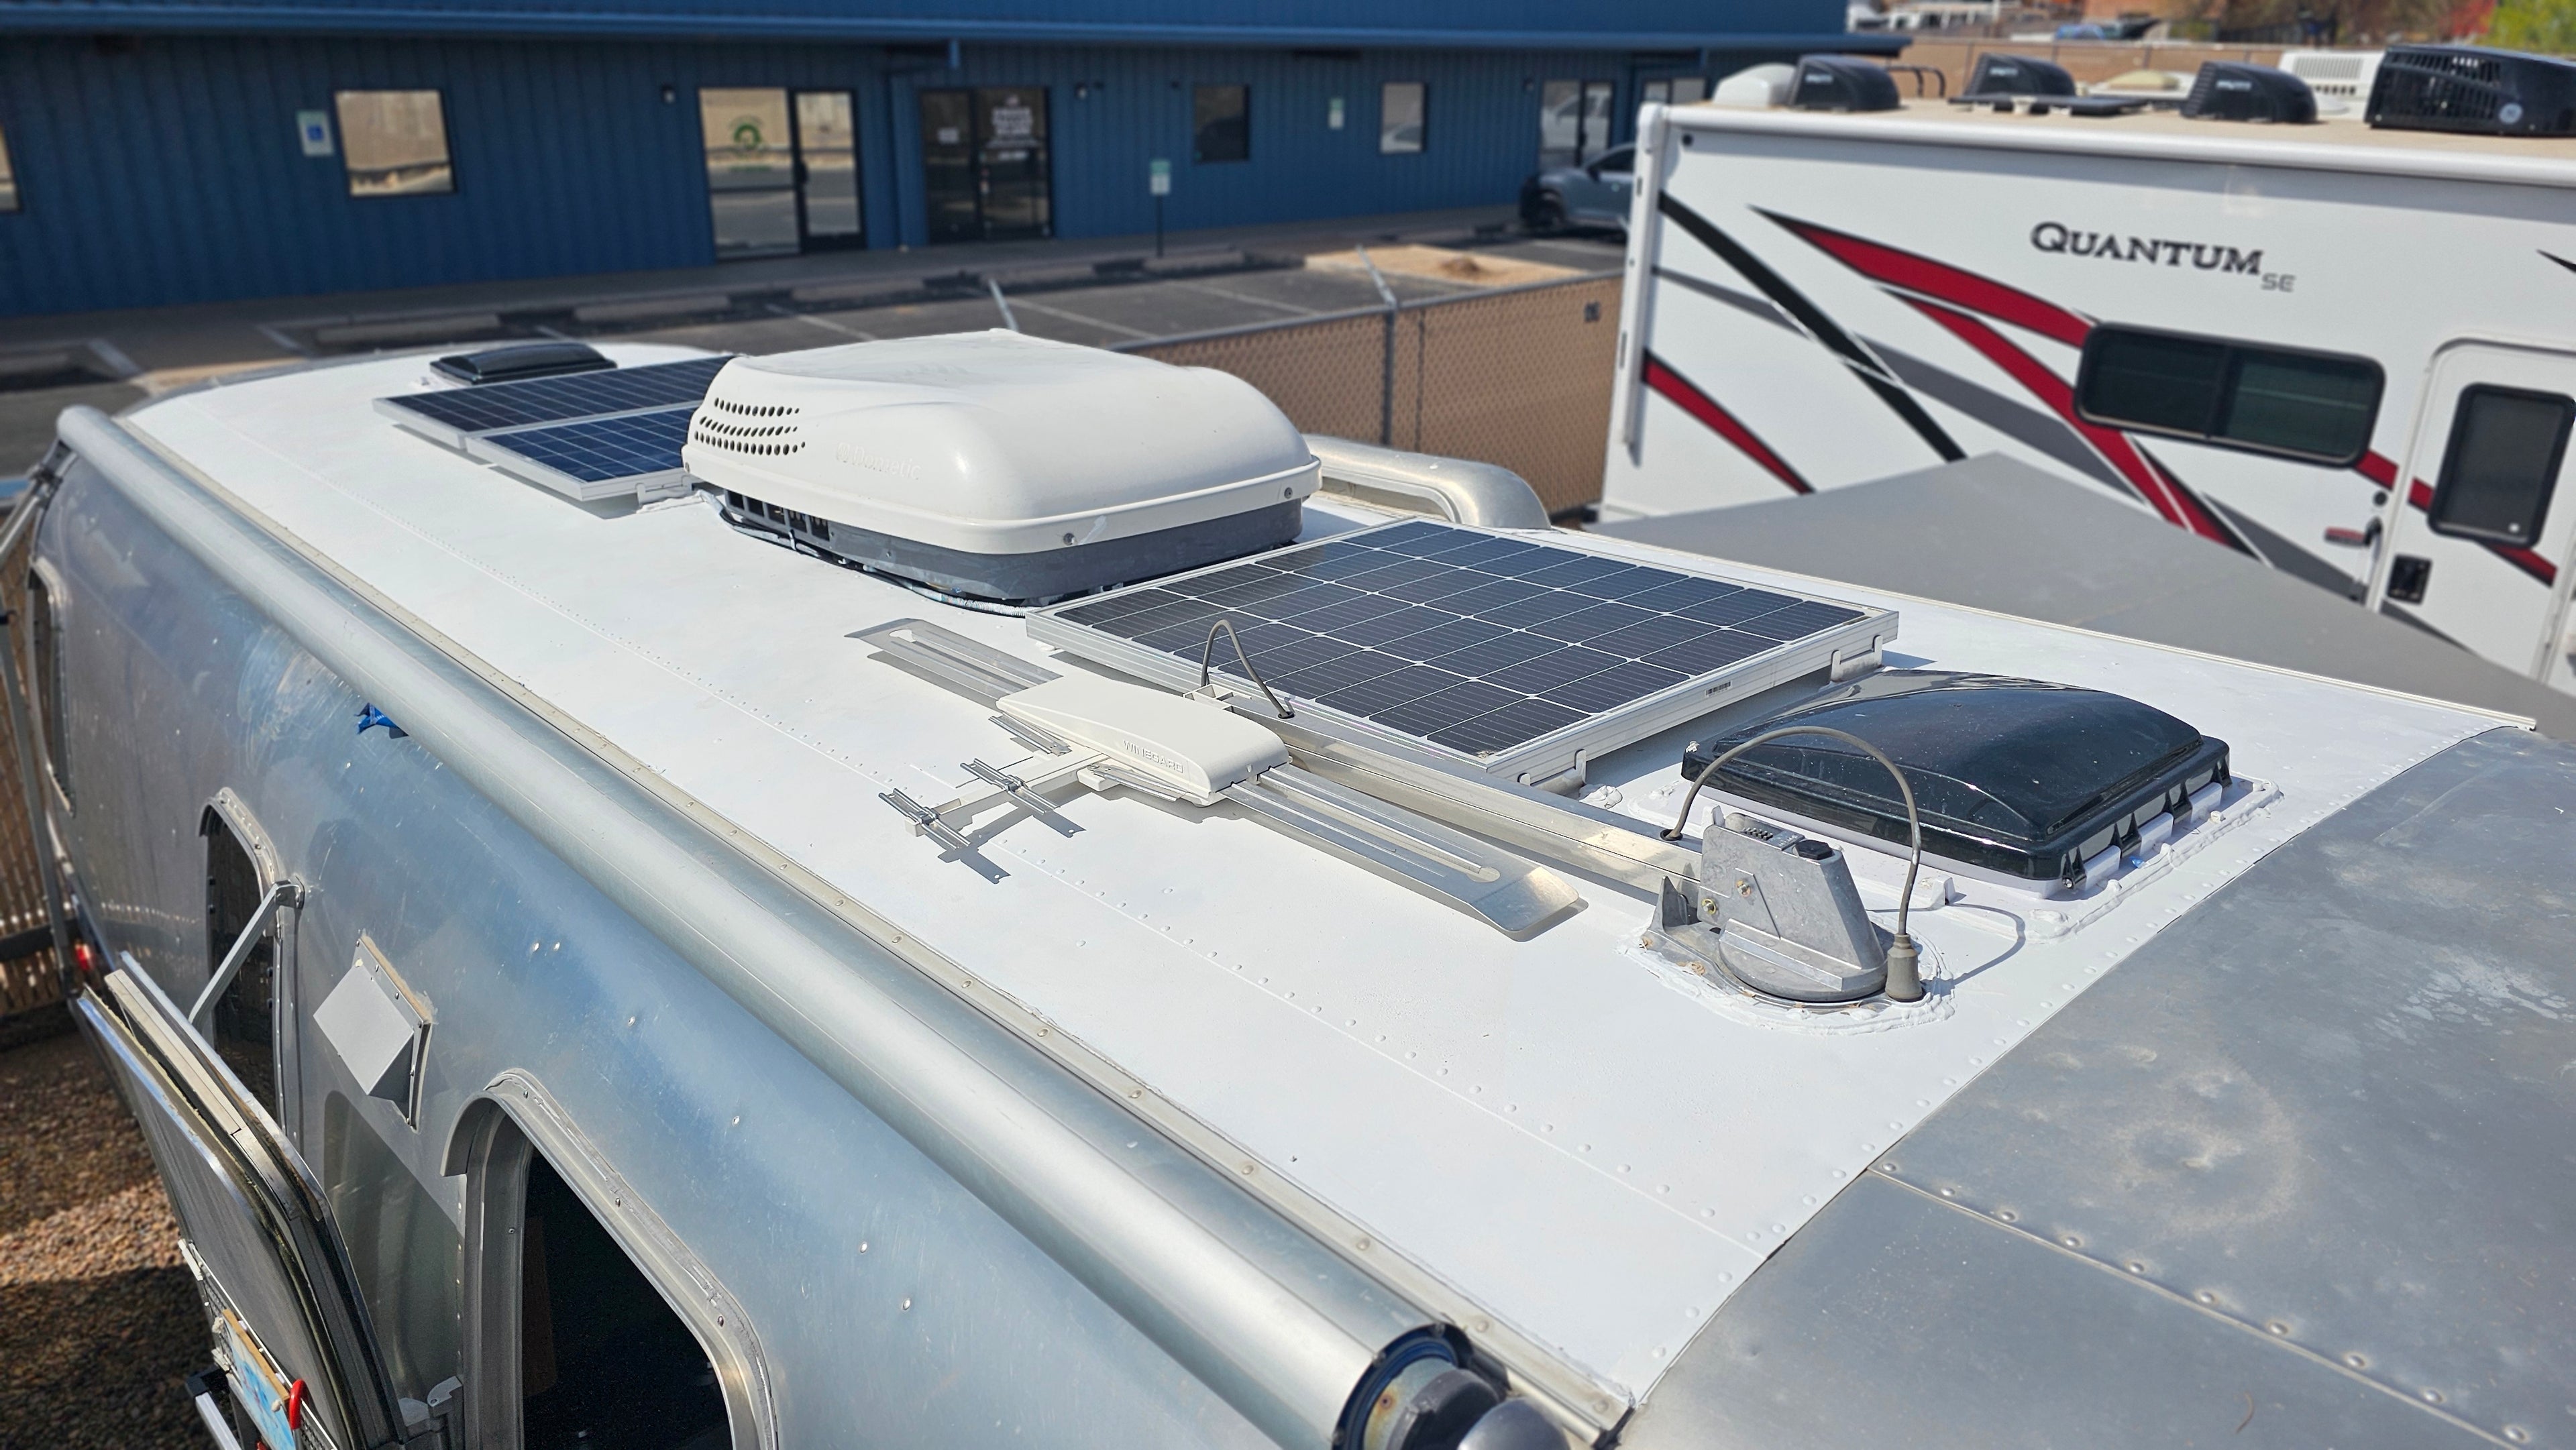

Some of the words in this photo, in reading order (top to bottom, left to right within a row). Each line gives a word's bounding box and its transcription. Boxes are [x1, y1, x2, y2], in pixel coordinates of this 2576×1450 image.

[2030, 221, 2263, 275] QUANTUM
[2261, 272, 2296, 292] SE
[853, 445, 922, 480] Dometic
[1124, 740, 1184, 773] WINEGARD
